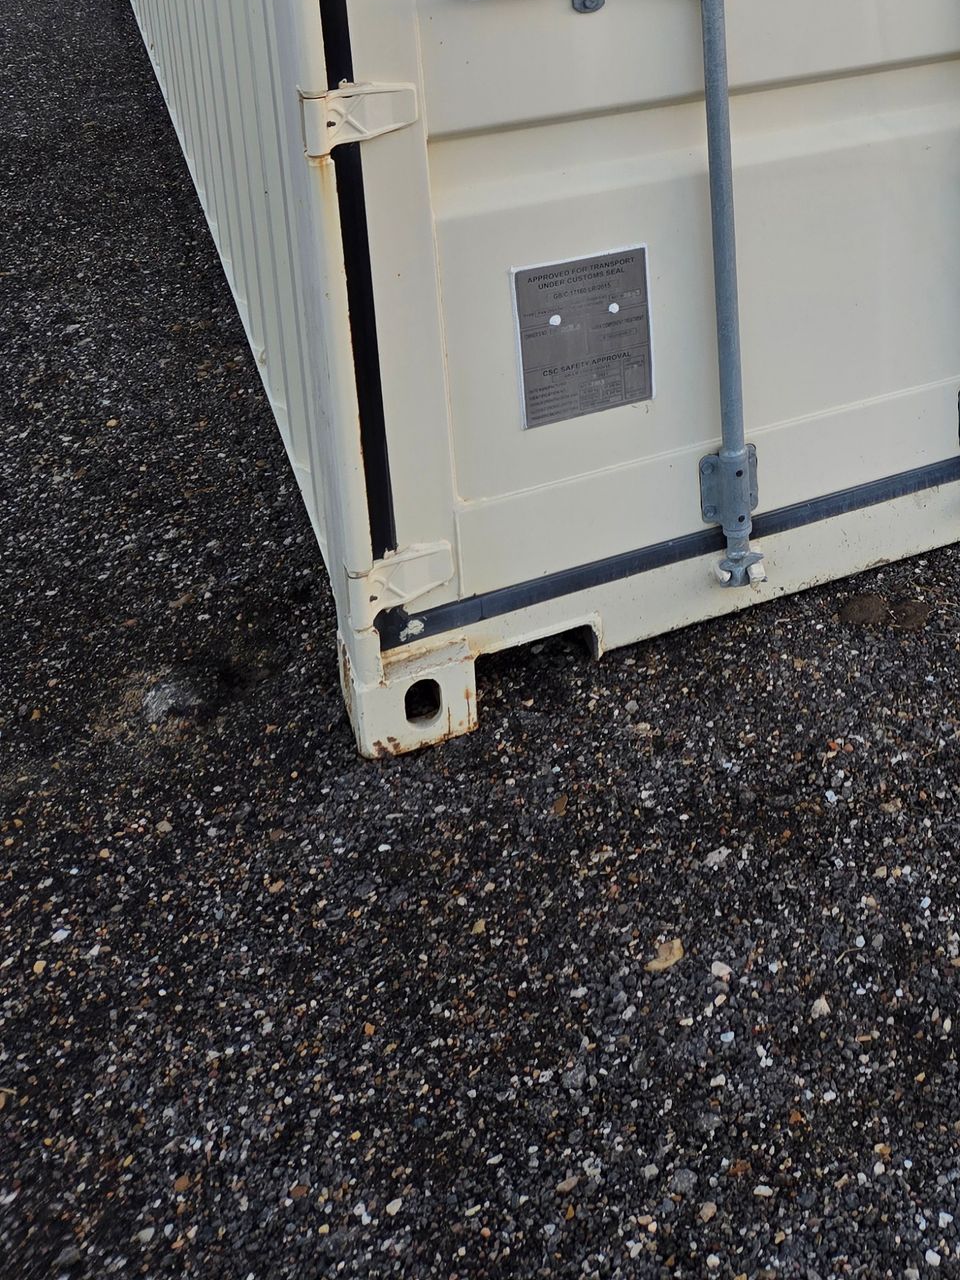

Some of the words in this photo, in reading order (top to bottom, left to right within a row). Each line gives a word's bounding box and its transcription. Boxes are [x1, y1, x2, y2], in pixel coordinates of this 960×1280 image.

[527, 270, 570, 284] APPROVED
[571, 267, 588, 276] FOR
[590, 256, 635, 271] TRANSPORT
[537, 278, 565, 290] UNDER
[566, 272, 605, 285] CUSTOMS
[605, 267, 624, 277] SEAL
[542, 368, 559, 378] CSC
[561, 361, 590, 373] SAFETY
[591, 351, 632, 365] APPROVAL
